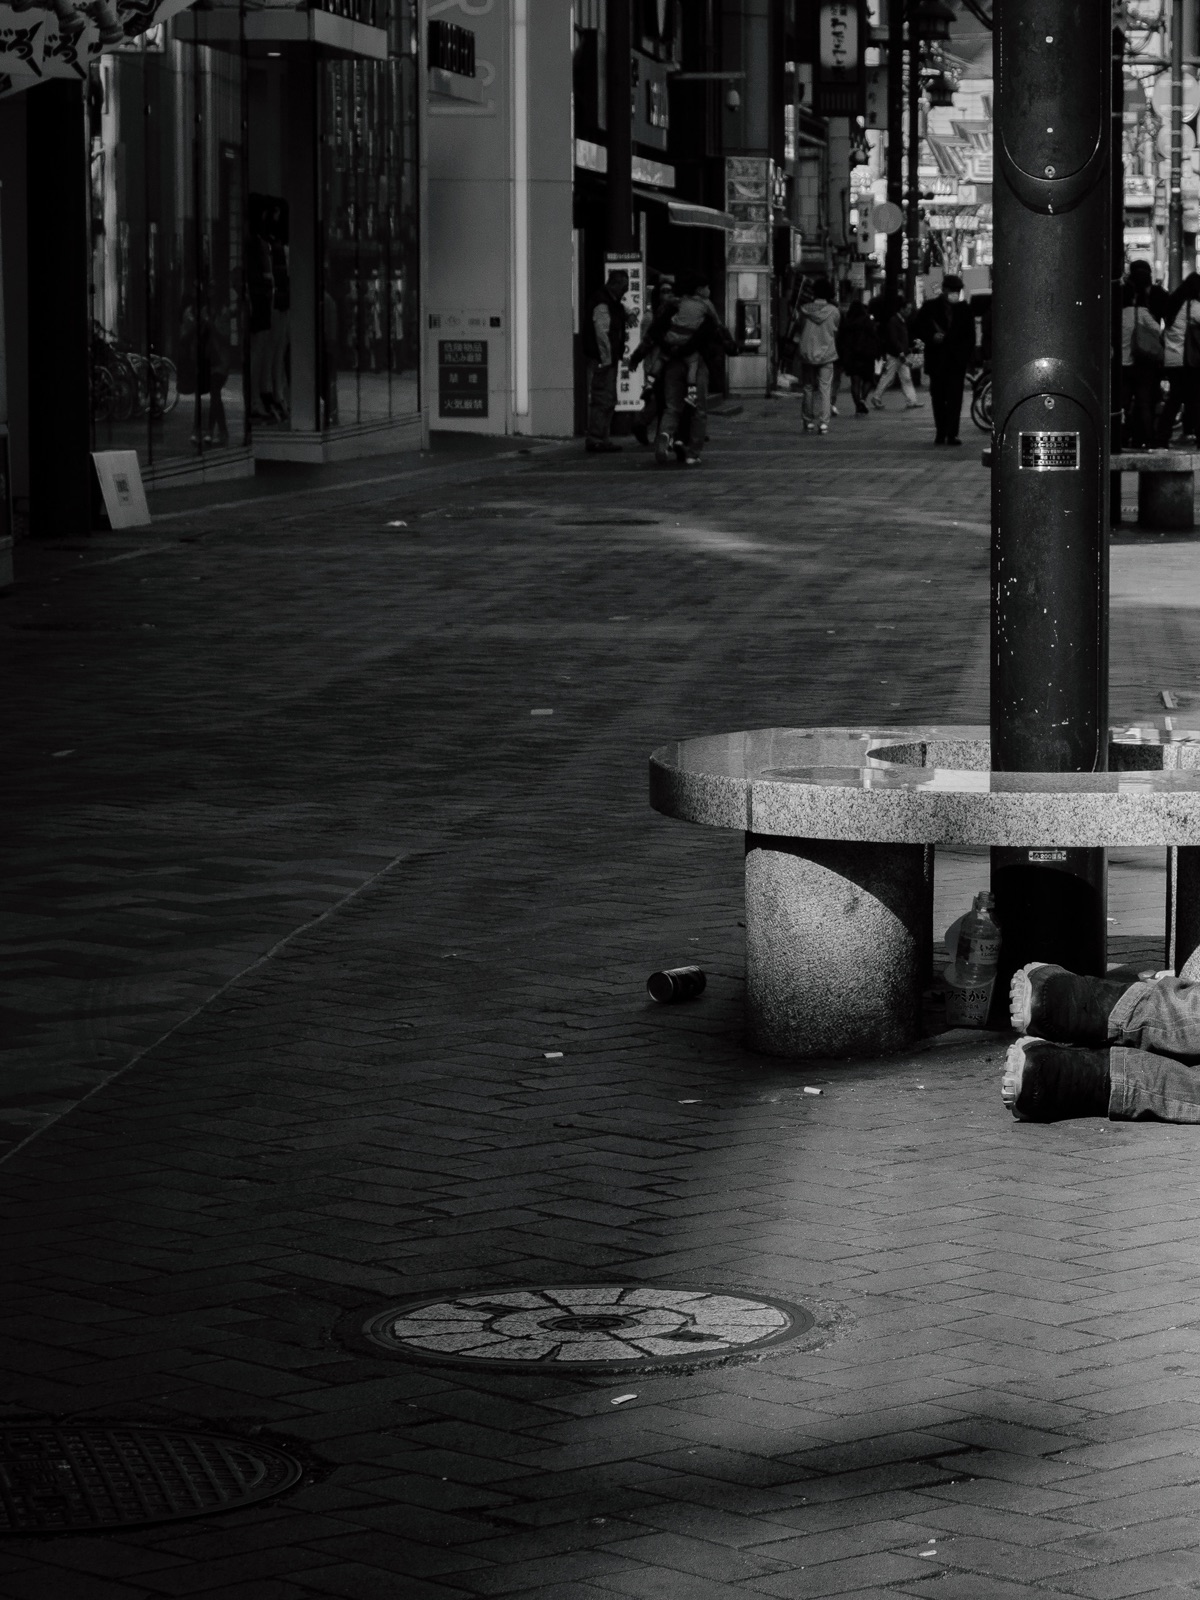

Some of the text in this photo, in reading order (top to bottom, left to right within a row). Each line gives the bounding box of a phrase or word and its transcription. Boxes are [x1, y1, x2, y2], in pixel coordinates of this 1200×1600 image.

[947, 990, 988, 1002] ファミから
